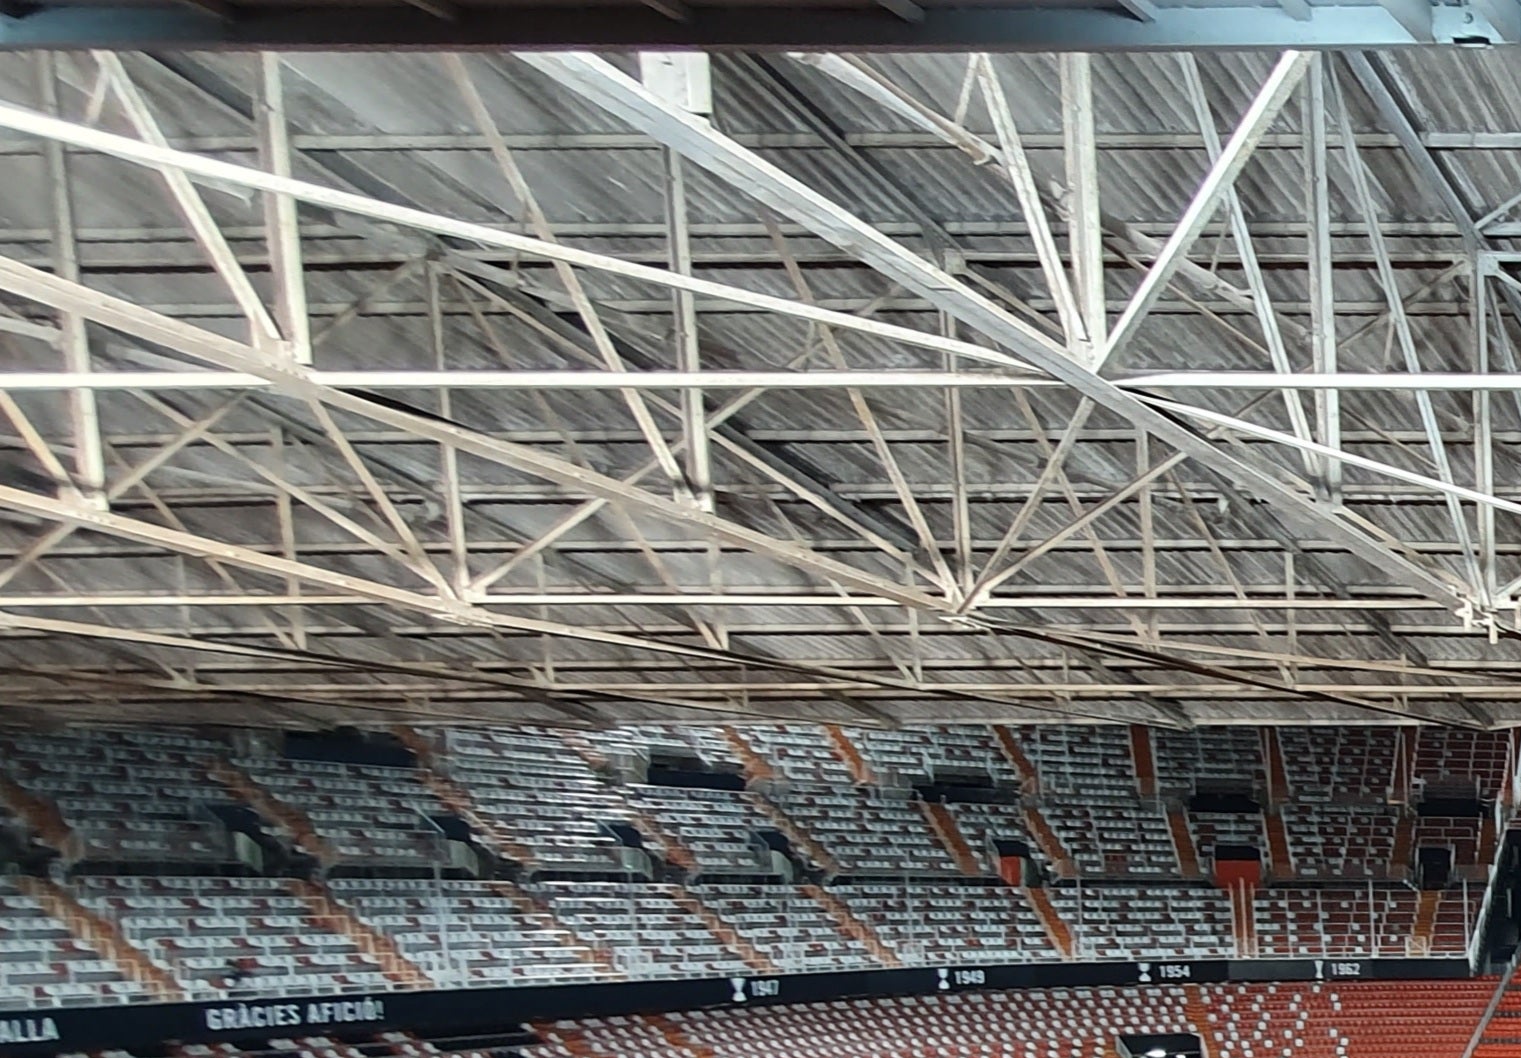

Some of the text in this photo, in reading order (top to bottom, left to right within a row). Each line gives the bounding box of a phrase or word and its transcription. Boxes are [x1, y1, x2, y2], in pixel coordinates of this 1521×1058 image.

[1159, 965, 1191, 979] 1954
[1332, 962, 1361, 977] 1962
[204, 1002, 302, 1031] GRÀCIES
